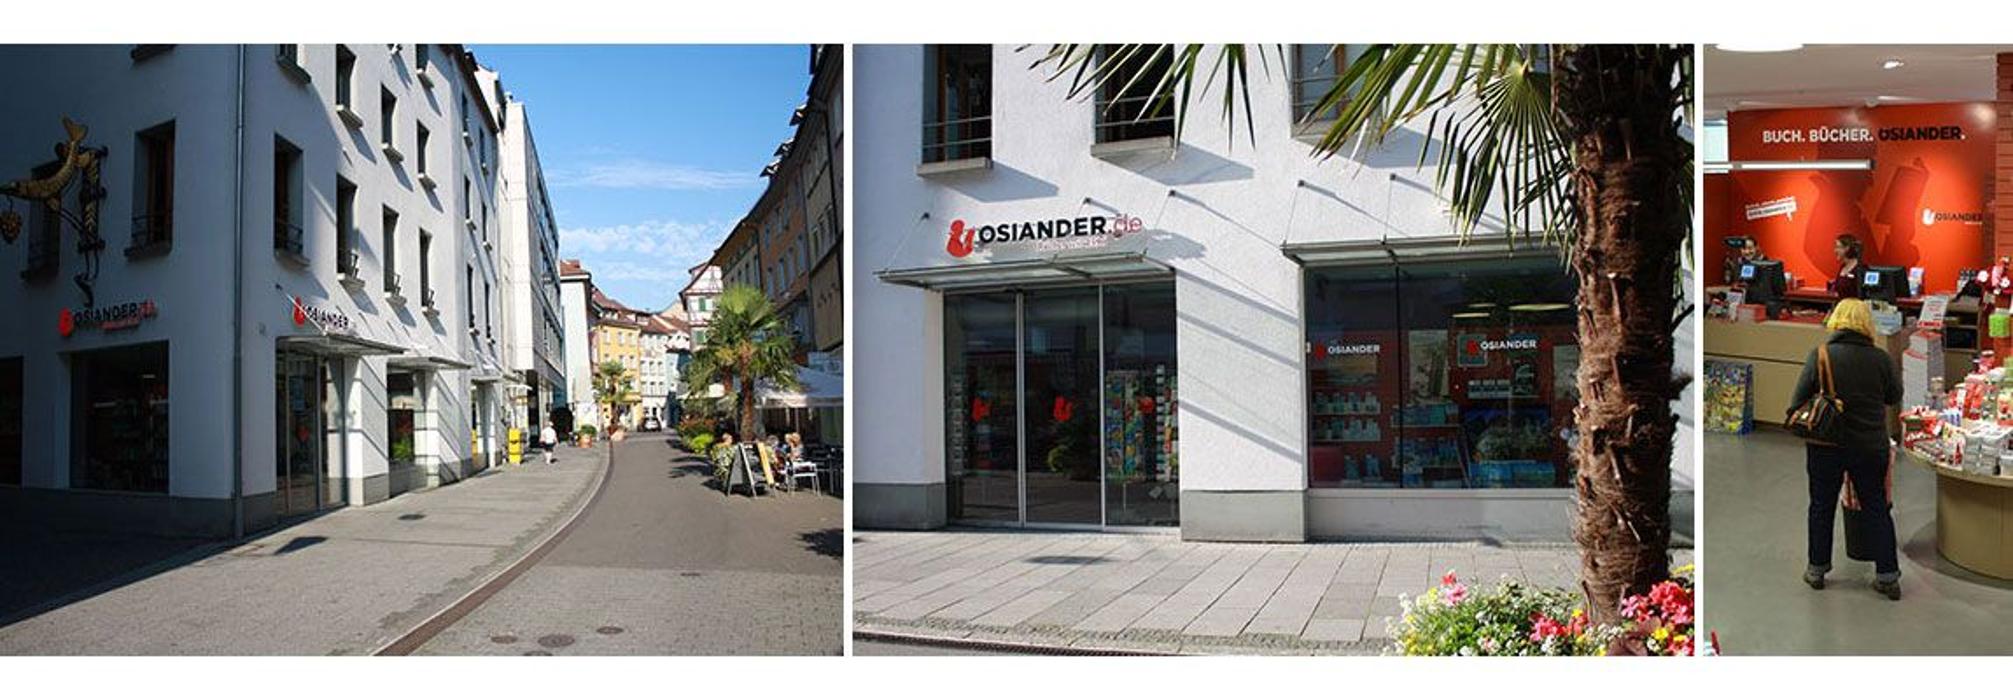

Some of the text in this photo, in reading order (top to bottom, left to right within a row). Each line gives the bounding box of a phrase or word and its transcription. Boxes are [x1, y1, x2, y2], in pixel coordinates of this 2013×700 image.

[1763, 129, 1805, 143] BUCH.
[1809, 126, 1874, 142] BÜCHER.
[1328, 344, 1380, 355] OSIANDER
[1480, 339, 1537, 351] OSIANDER
